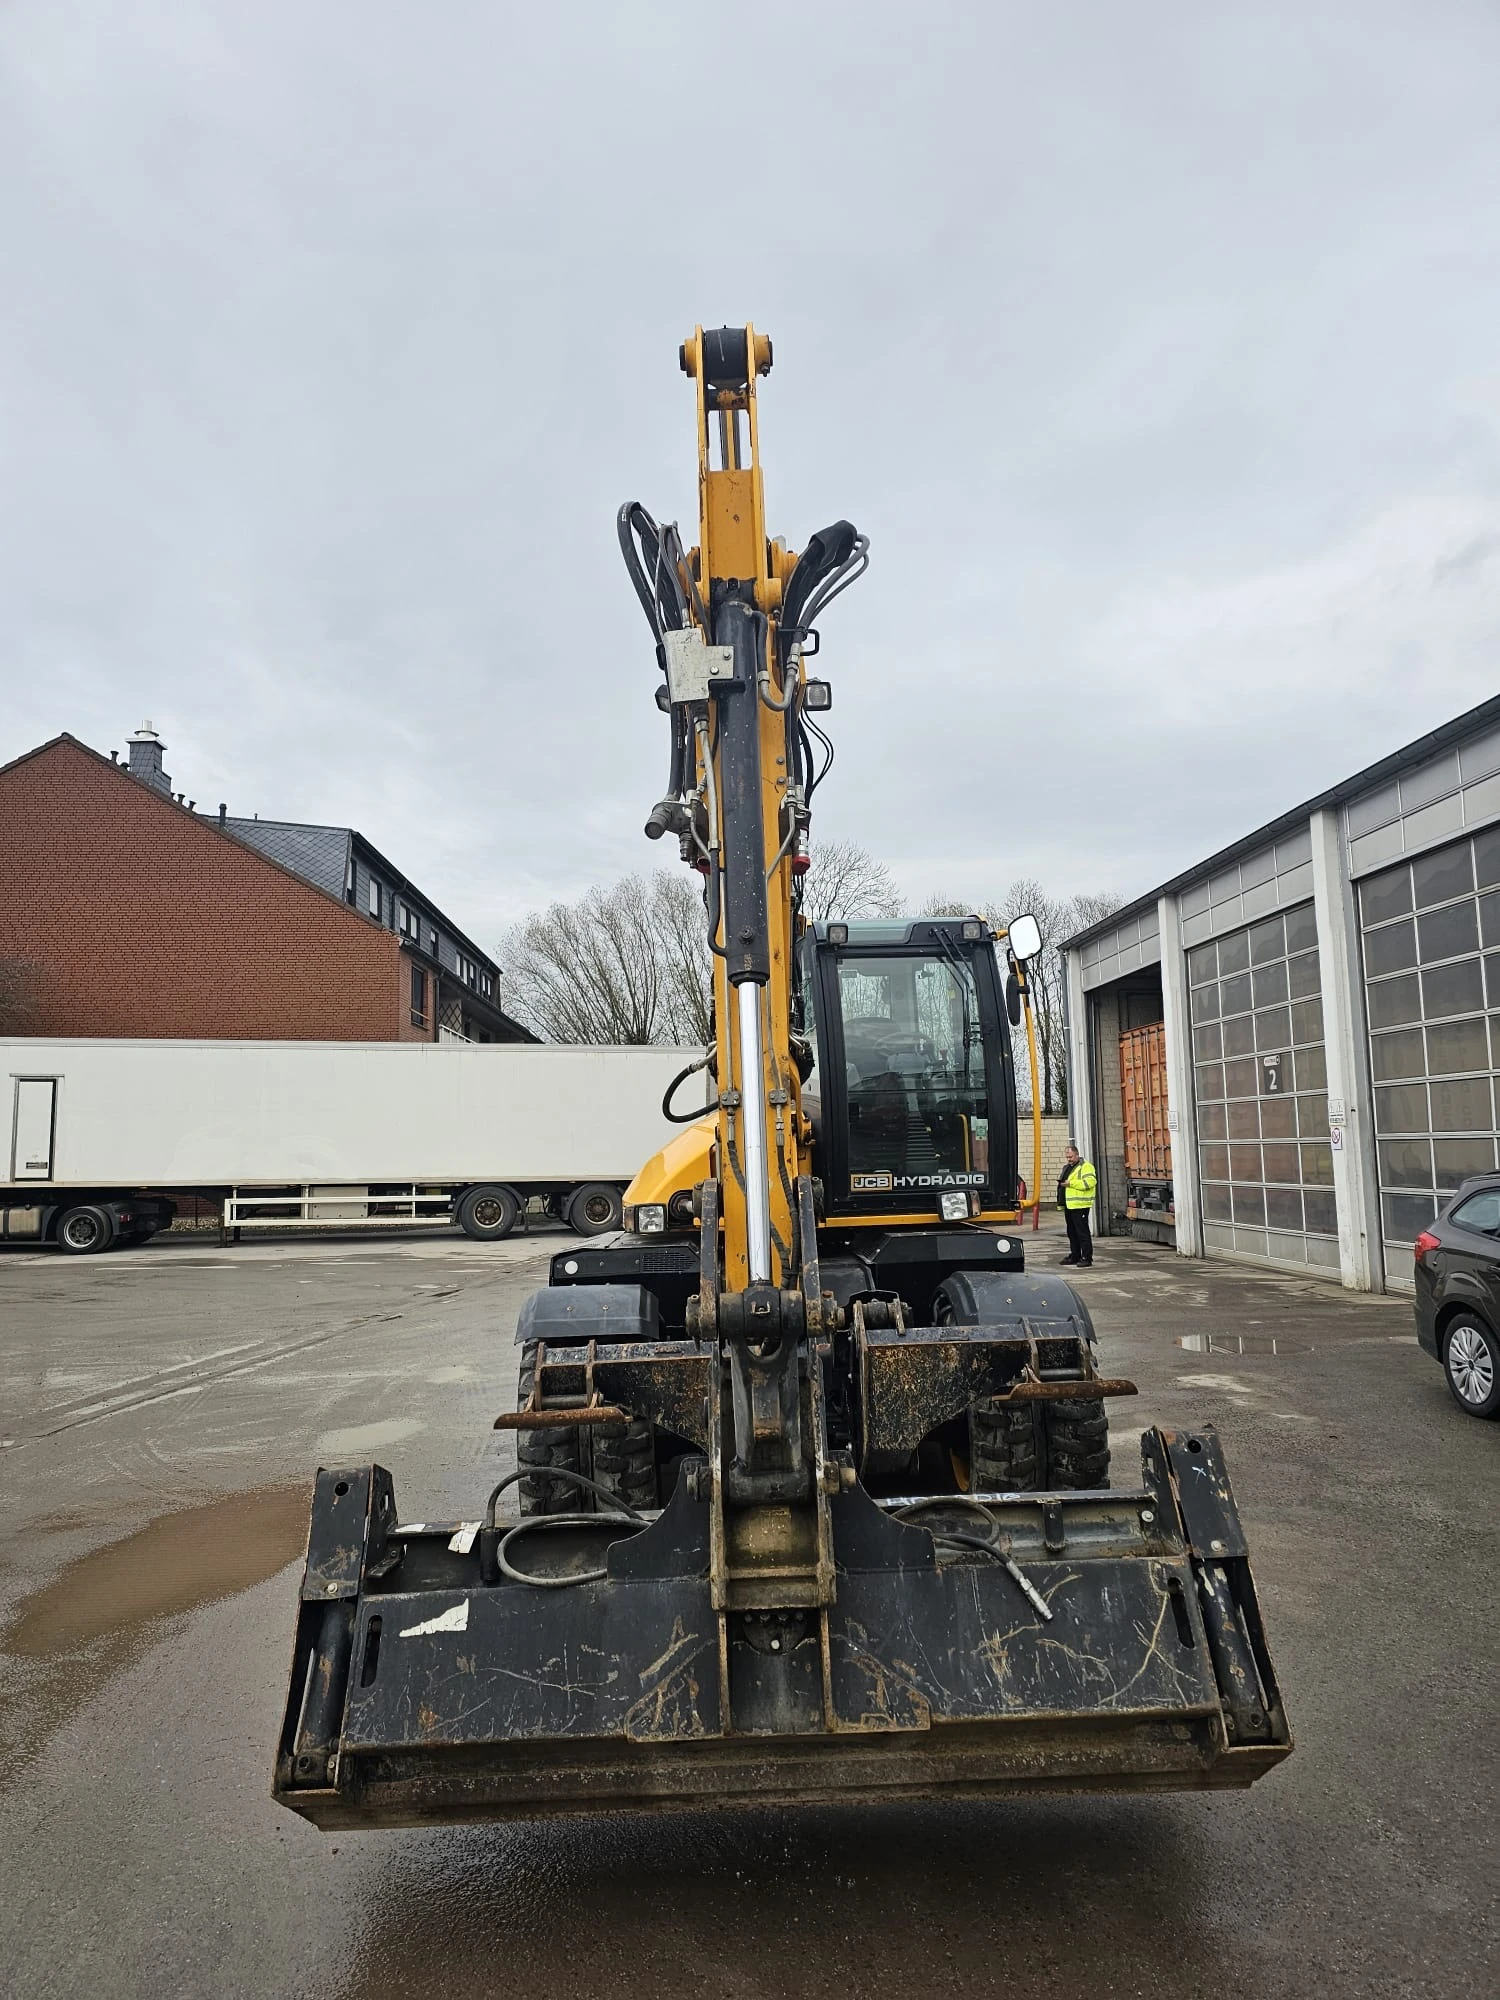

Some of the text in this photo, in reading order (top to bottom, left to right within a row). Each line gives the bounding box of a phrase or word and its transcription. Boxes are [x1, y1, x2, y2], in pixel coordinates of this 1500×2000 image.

[1269, 1069, 1278, 1090] 2
[854, 1174, 985, 1188] JCB HYDRADIG
